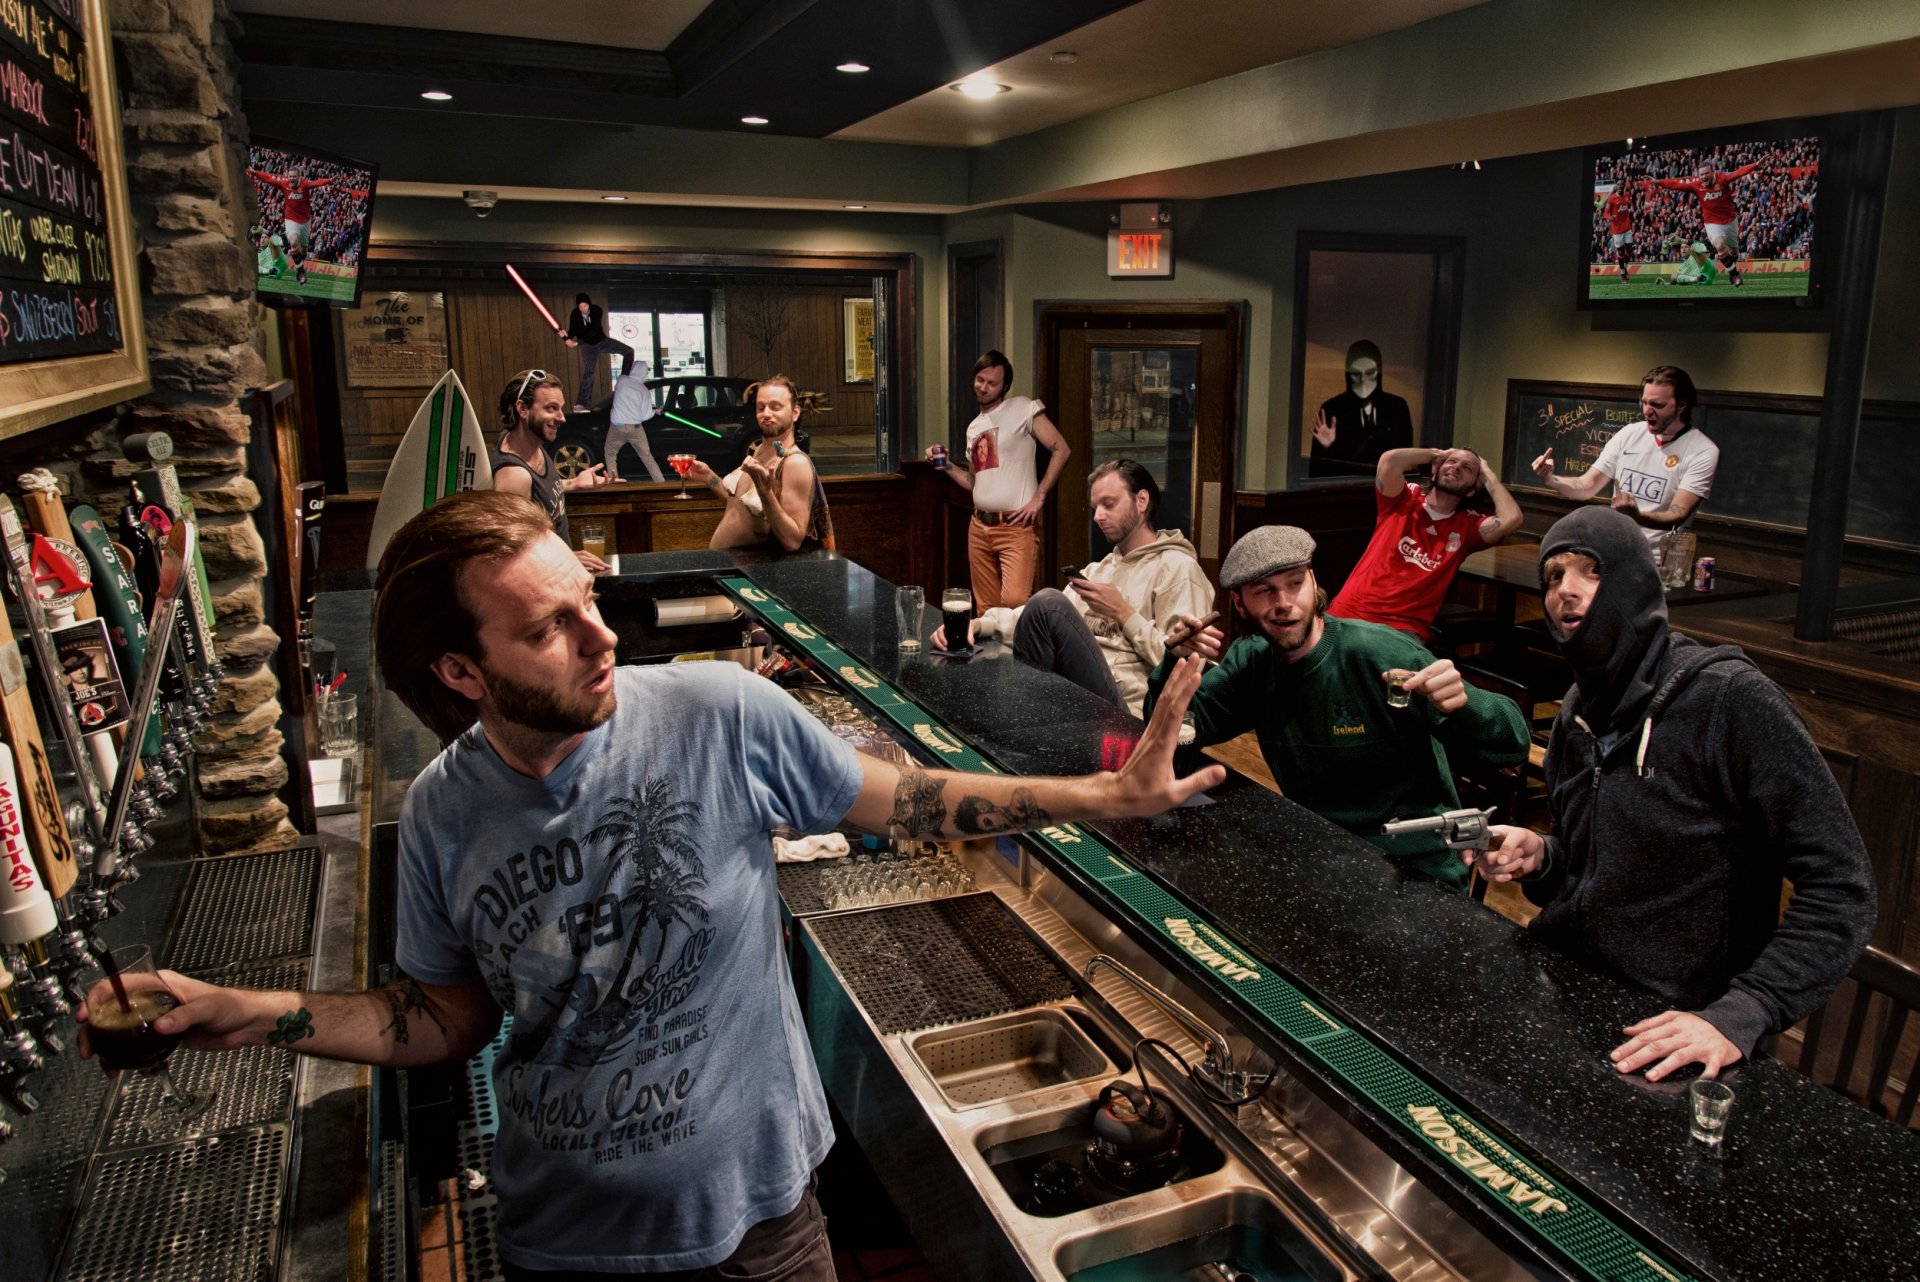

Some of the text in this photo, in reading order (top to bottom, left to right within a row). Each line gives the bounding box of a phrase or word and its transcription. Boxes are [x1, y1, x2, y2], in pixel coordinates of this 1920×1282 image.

[1119, 234, 1161, 269] EXIT
[363, 315, 424, 326] HOME OF
[376, 297, 409, 316] The
[1554, 402, 1594, 428] SPECIAL
[1621, 474, 1662, 501] AIG
[75, 686, 98, 701] JOE'S
[1333, 724, 1365, 736] Ireland
[473, 837, 584, 930] DIEGO
[1164, 916, 1261, 982] JAMESON
[638, 1004, 708, 1044] FIND PARADISE
[606, 1068, 697, 1122] Cove
[632, 1137, 653, 1155] THE
[662, 1120, 697, 1147] WAVE
[1453, 1114, 1557, 1191] IRISH WHISKEY
[1407, 1103, 1568, 1215] JAMESON
